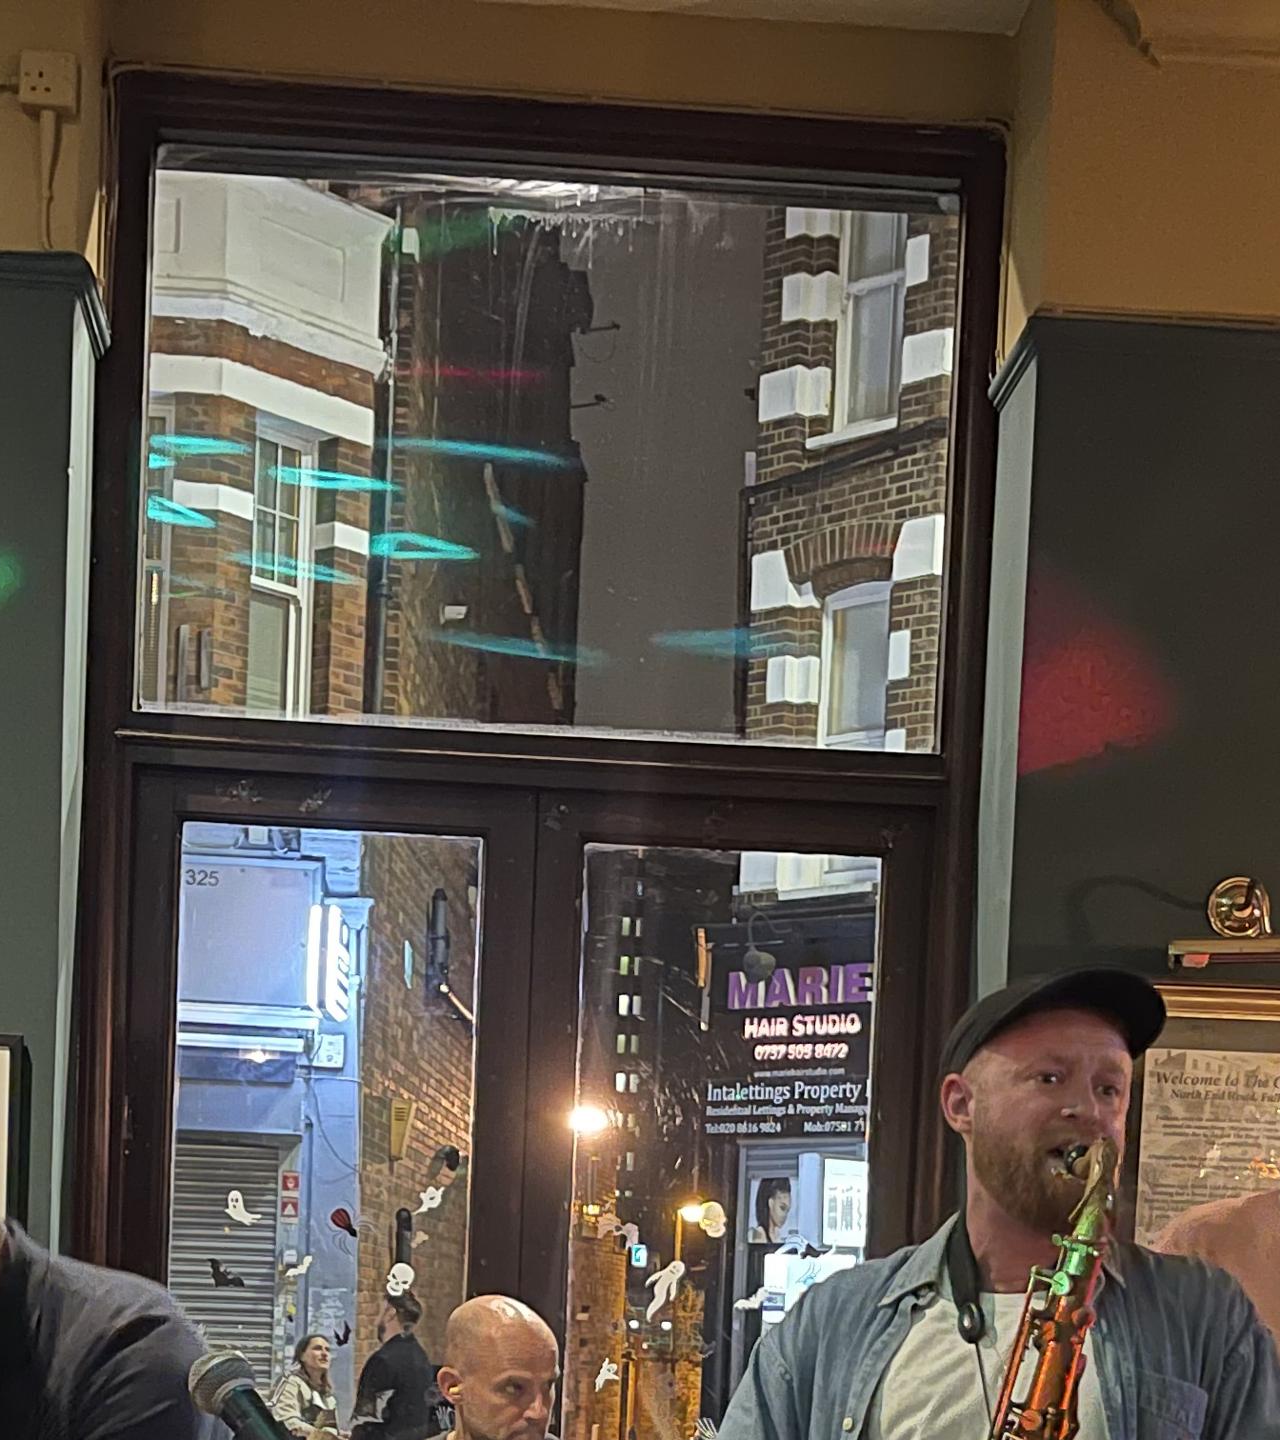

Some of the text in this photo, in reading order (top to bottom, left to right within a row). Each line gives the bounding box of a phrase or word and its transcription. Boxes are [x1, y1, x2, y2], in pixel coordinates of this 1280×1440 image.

[185, 868, 220, 887] 325
[728, 963, 872, 1009] MARIE
[744, 1014, 862, 1038] HAIR STUDIO
[1157, 1072, 1221, 1086] Welcome
[1225, 1073, 1239, 1087] to
[707, 1081, 862, 1104] Intalettings Property
[1171, 1089, 1201, 1100] North
[706, 1104, 752, 1116] Residential
[753, 1104, 786, 1117] Lettings
[787, 1103, 795, 1115] &
[796, 1103, 834, 1117] Property
